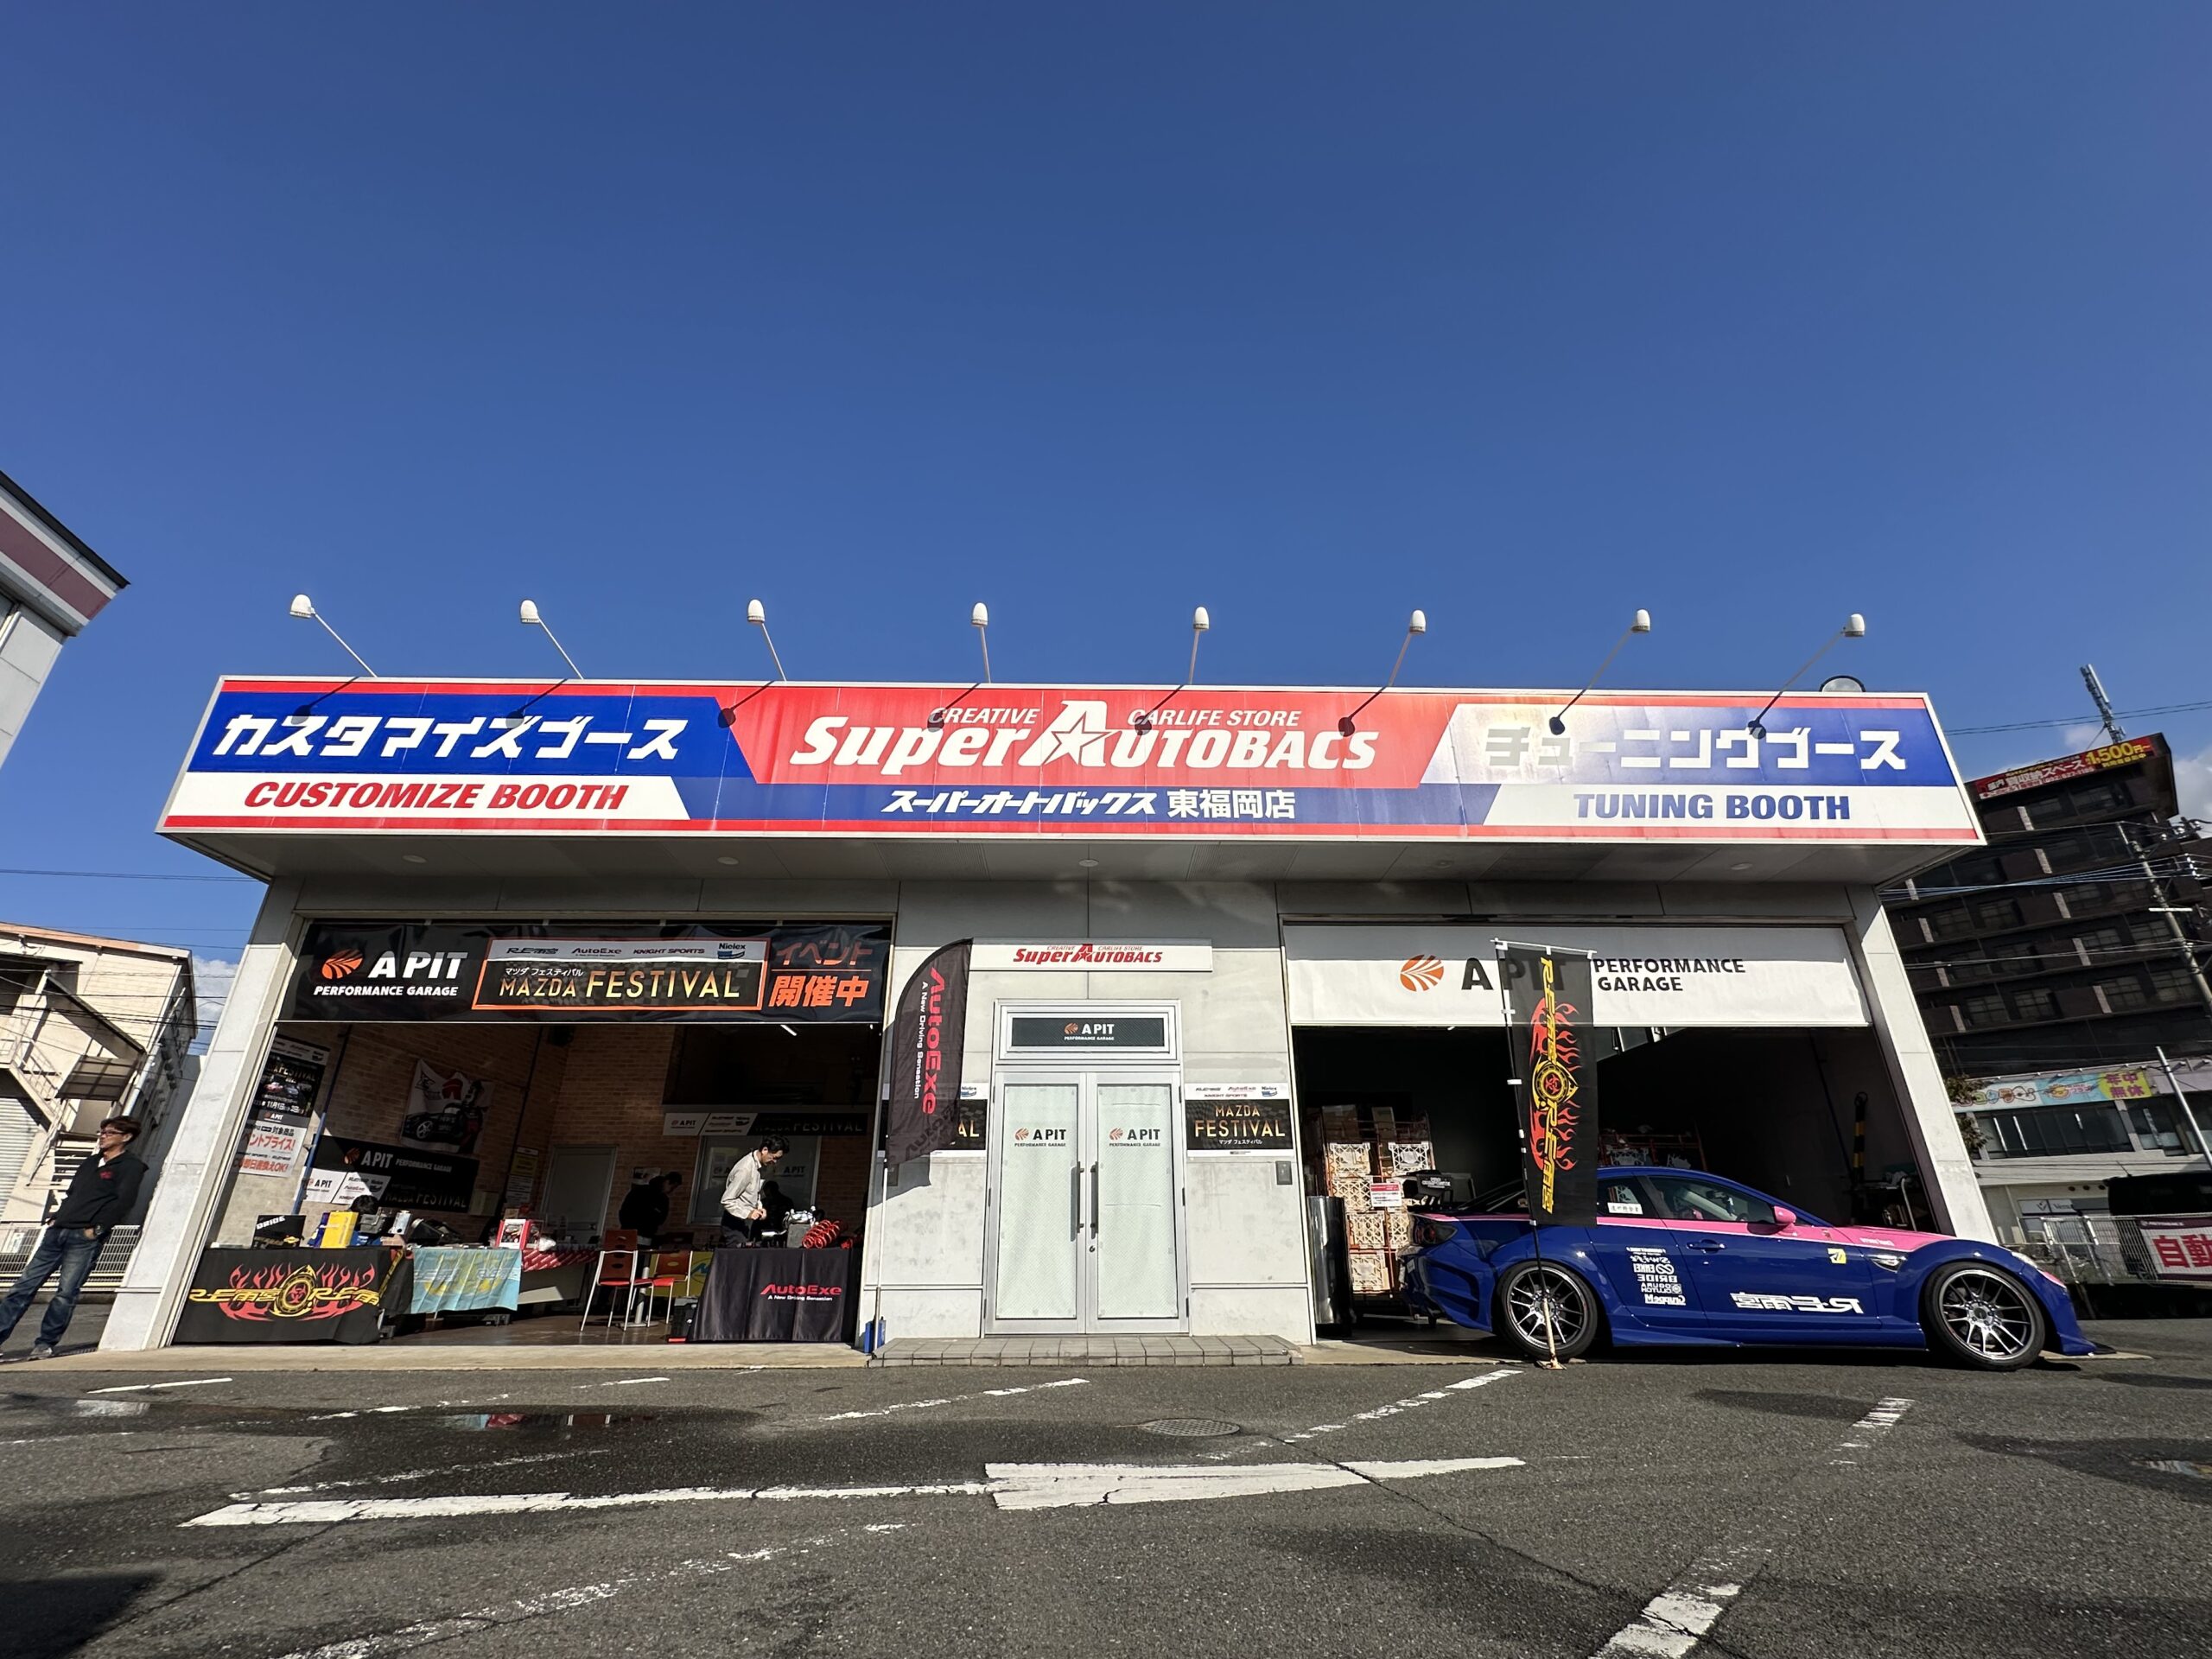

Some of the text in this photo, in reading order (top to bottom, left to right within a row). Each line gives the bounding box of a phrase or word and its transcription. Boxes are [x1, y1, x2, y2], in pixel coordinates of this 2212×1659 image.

[930, 708, 1300, 727] CREATIVE CARLIFE STORE
[789, 717, 1022, 775] Super
[244, 781, 629, 810] CUSTOMIZE BOOTH
[880, 790, 1296, 819] スーパーオートバックス 東福岡店
[1573, 793, 1851, 820] TUNING BOOTH
[778, 941, 873, 965] イベント
[1013, 949, 1073, 964] Super
[1593, 958, 1746, 974] PERFORMANCE
[313, 986, 459, 996] PERFORMANCE GARAGE
[499, 970, 740, 998] MAZDA FESTIVAL
[768, 976, 869, 1007] 開催中
[1598, 976, 1683, 991] GARAGE
[915, 1015, 926, 1049] Driving
[922, 966, 945, 1115] AutoExe
[913, 1052, 924, 1099] Sensation
[1215, 1105, 1261, 1117] MAZDA
[1194, 1120, 1286, 1137] FESTIVAL
[760, 1284, 842, 1295] AutoExe
